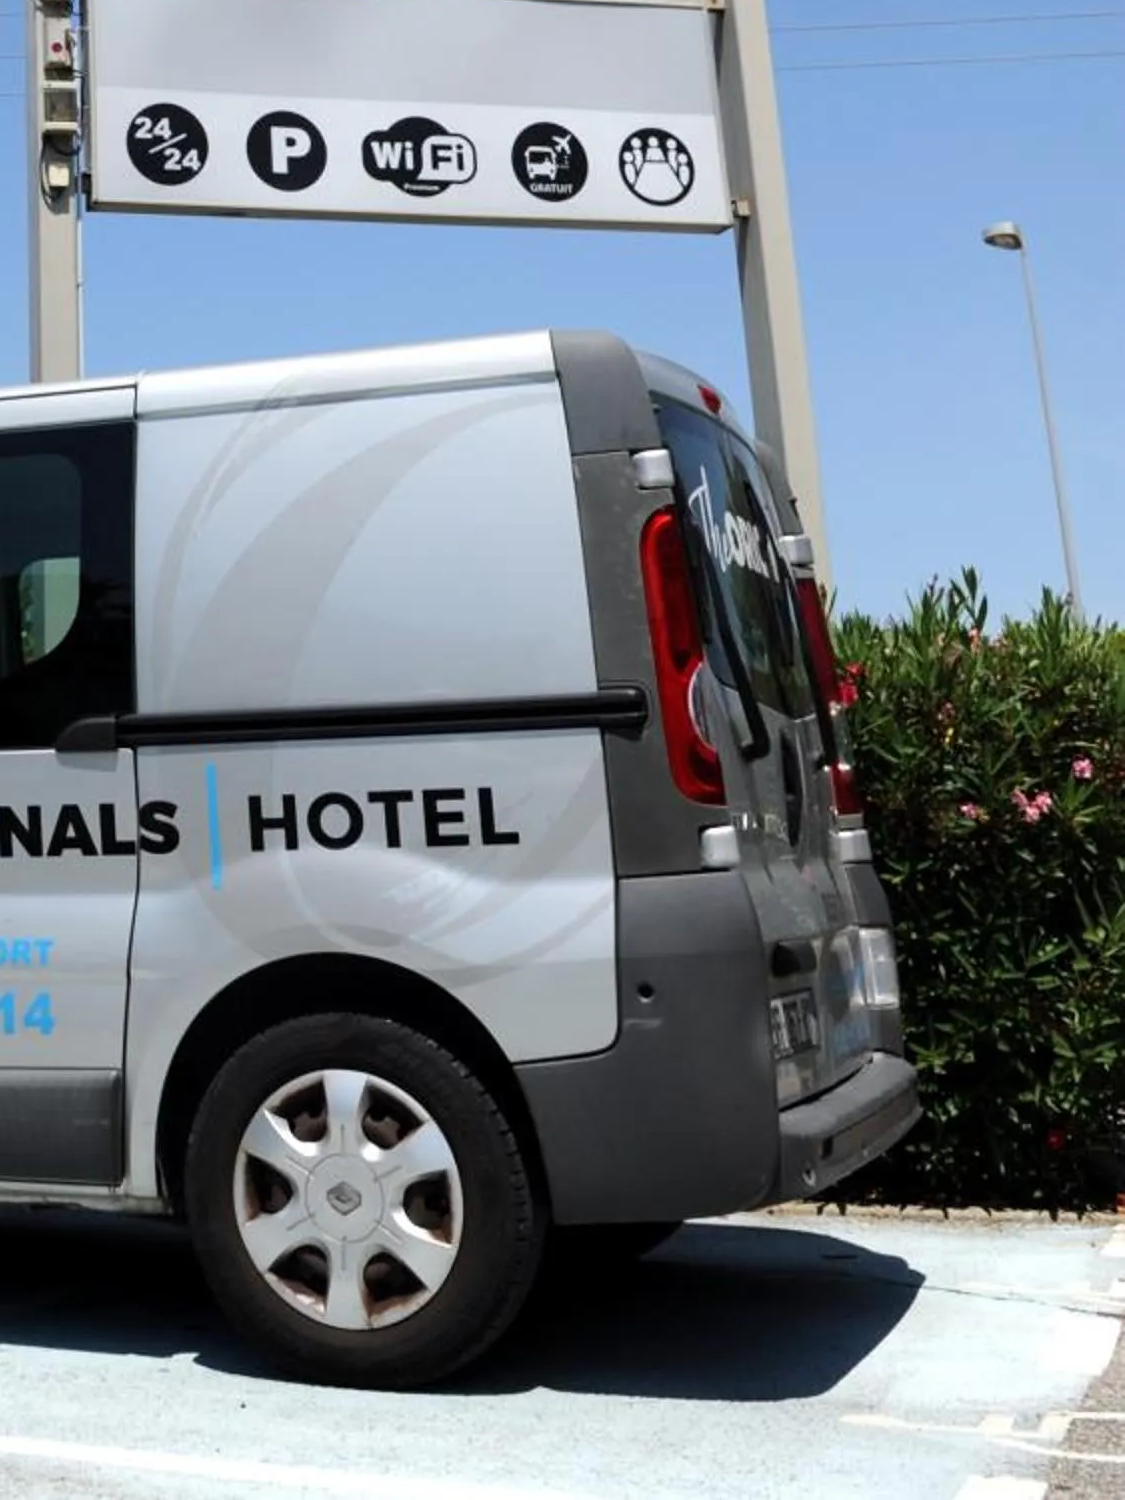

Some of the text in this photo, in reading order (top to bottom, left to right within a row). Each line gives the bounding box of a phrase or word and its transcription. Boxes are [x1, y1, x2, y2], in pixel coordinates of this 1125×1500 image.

[270, 126, 312, 175] P
[530, 183, 573, 193] GRATUIT
[247, 787, 520, 852] HOTEL
